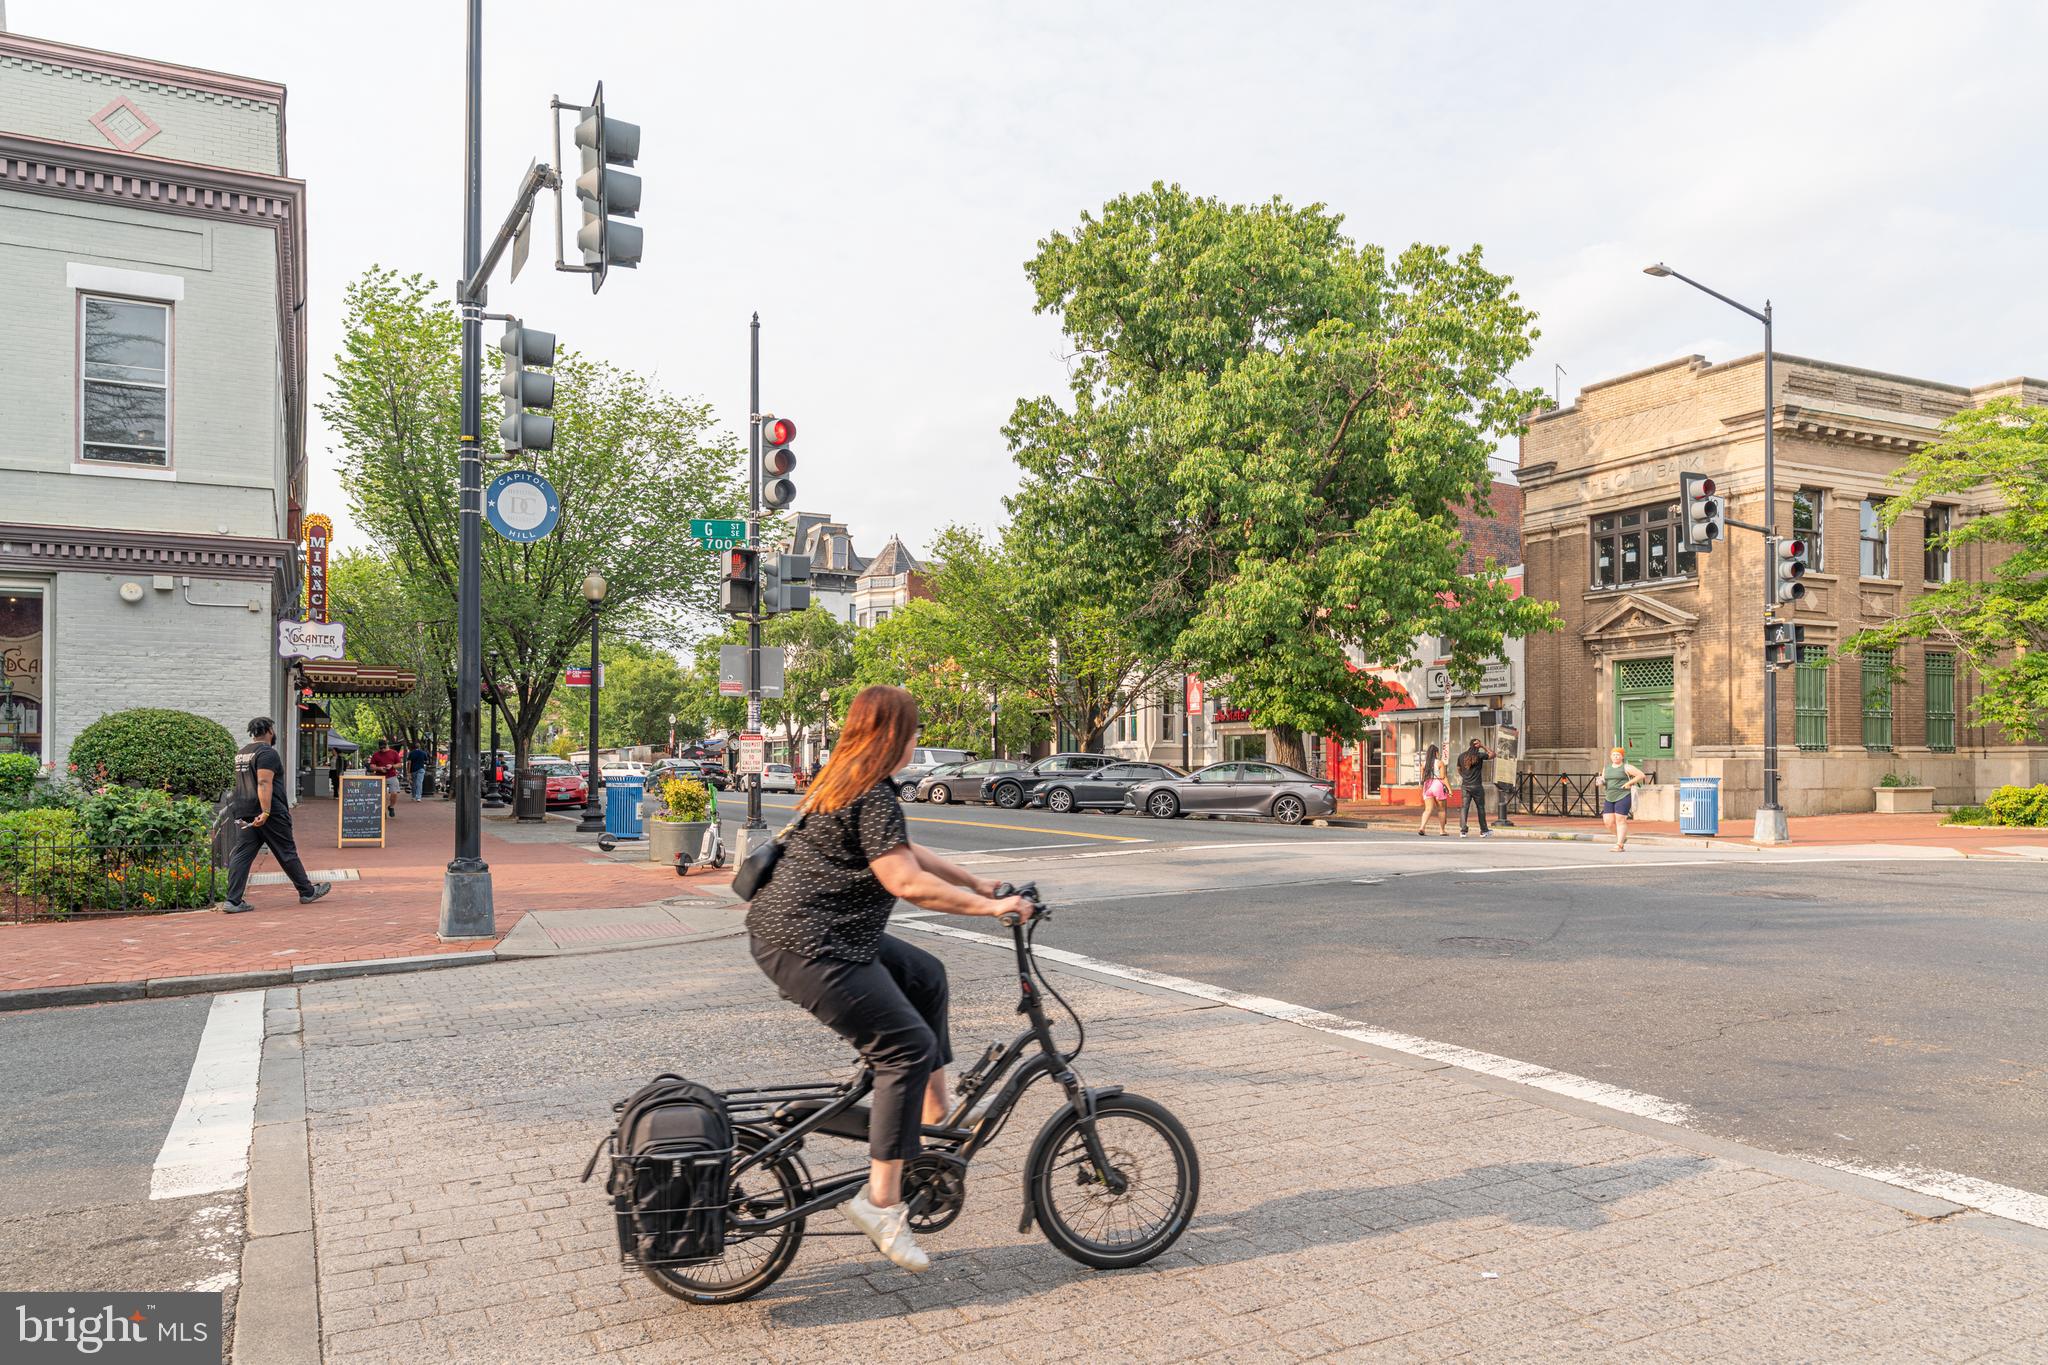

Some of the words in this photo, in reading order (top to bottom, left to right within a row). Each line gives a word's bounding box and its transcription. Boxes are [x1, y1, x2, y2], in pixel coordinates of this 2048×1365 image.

[1657, 456, 1701, 477] BANK
[498, 473, 545, 489] CAPITOL
[508, 529, 536, 539] HILL
[704, 522, 713, 536] G
[706, 538, 733, 550] 700
[292, 633, 336, 645] DCANTER
